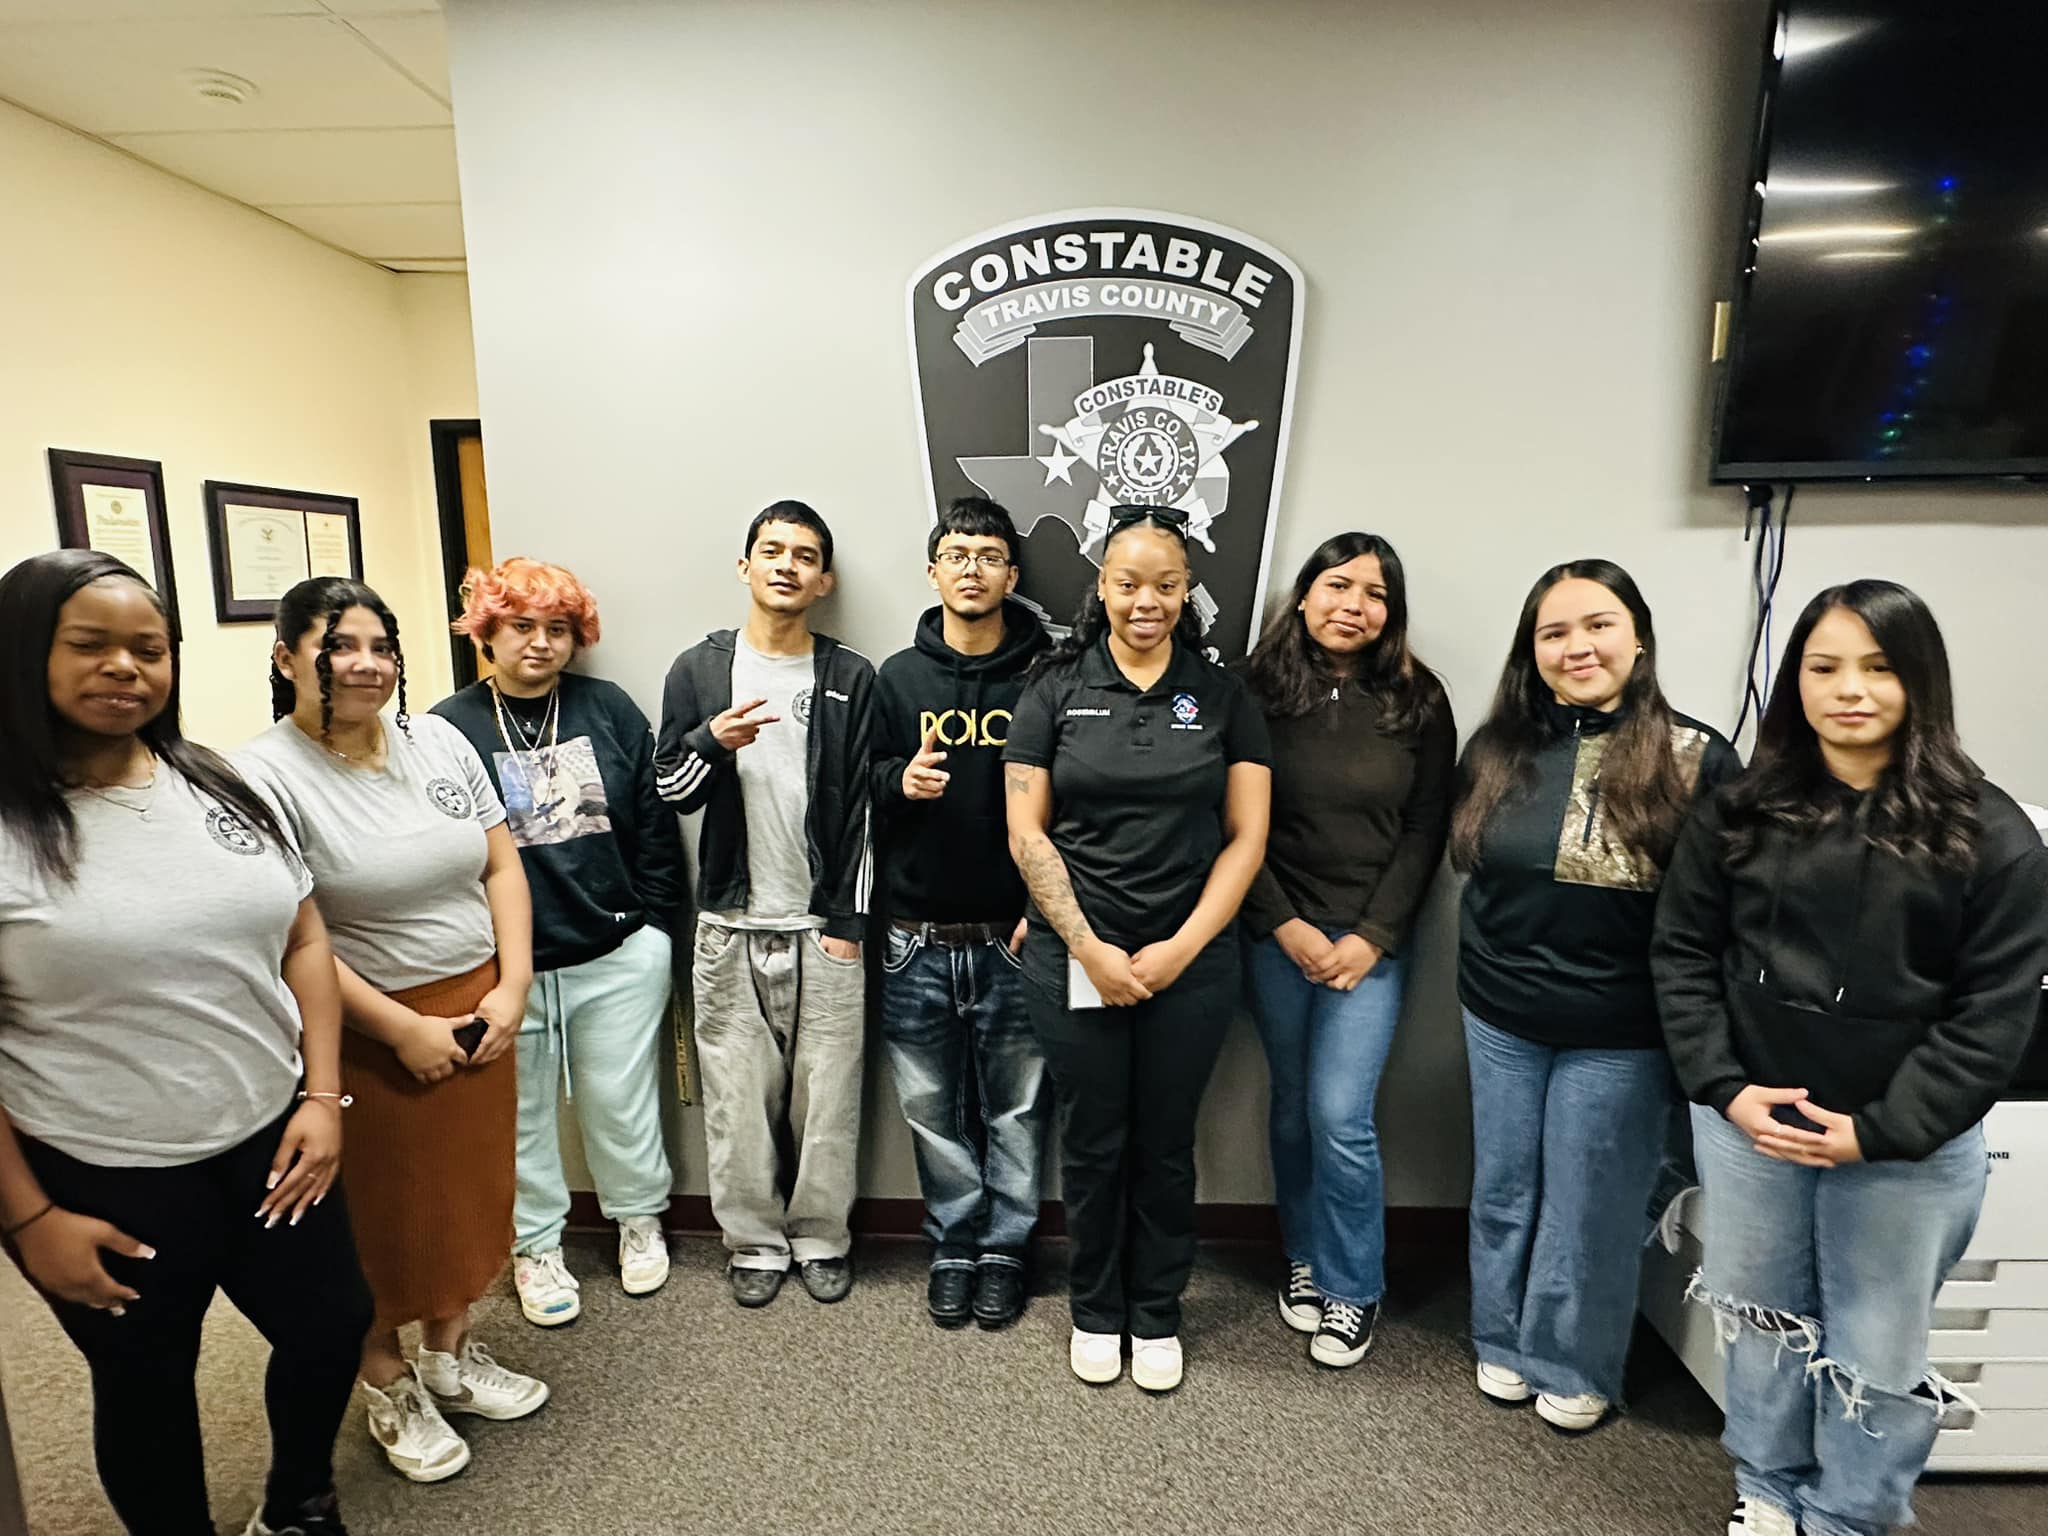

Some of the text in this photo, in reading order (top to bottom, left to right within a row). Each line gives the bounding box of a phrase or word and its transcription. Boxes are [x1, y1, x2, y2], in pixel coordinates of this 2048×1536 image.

[933, 231, 1273, 311] CONSTABLE
[980, 284, 1229, 328] TRAVIS COUNTY
[1079, 378, 1221, 414] CONSTABLE'S
[1100, 410, 1196, 470] TRAVIS CO. TX
[1115, 483, 1179, 506] PCT. 2
